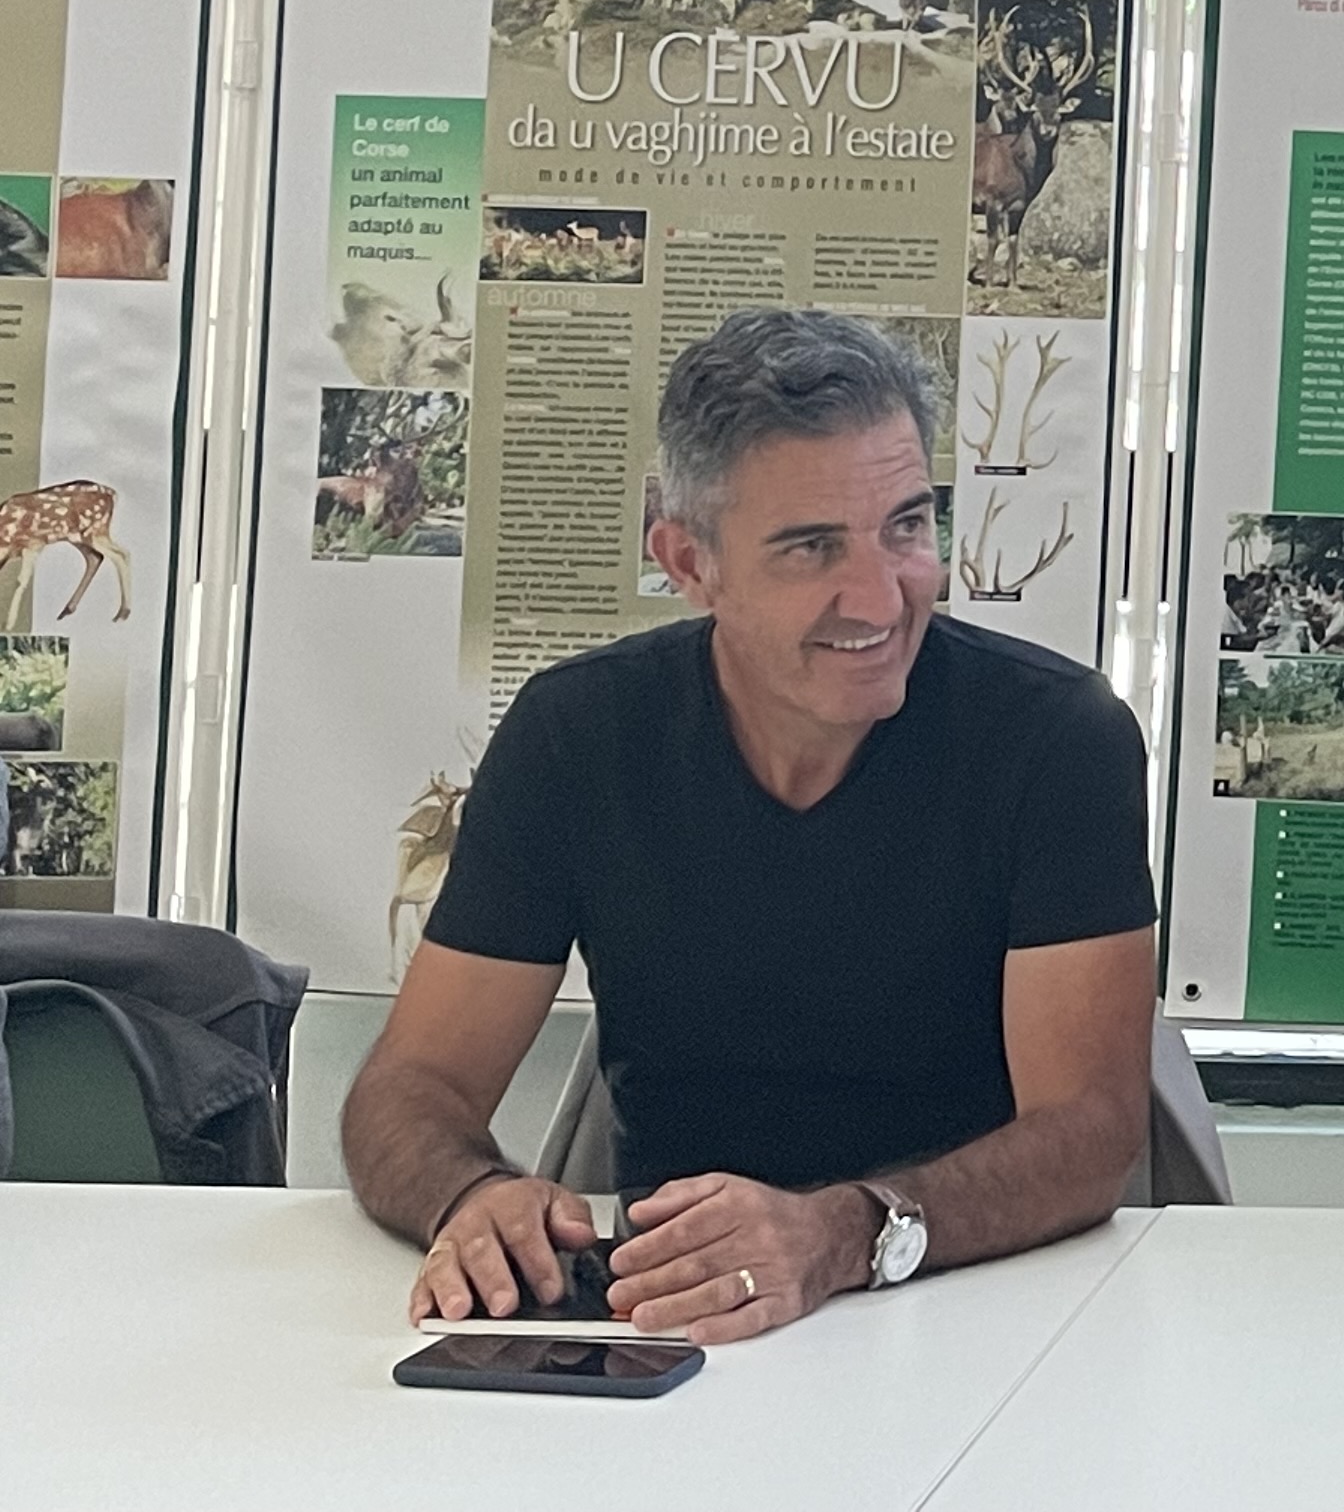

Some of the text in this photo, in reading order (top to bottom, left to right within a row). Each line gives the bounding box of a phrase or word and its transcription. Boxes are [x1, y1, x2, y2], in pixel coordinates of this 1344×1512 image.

[567, 30, 906, 110] U CERVU
[354, 114, 450, 133] Le cerf de
[508, 103, 956, 166] da u vaghjime à l'estate
[352, 139, 410, 158] Corse
[351, 167, 443, 183] un animal
[538, 168, 916, 193] mode de vie et comportement
[350, 192, 470, 210] parfaitement
[348, 218, 443, 236] adapté au
[487, 286, 597, 307] automne
